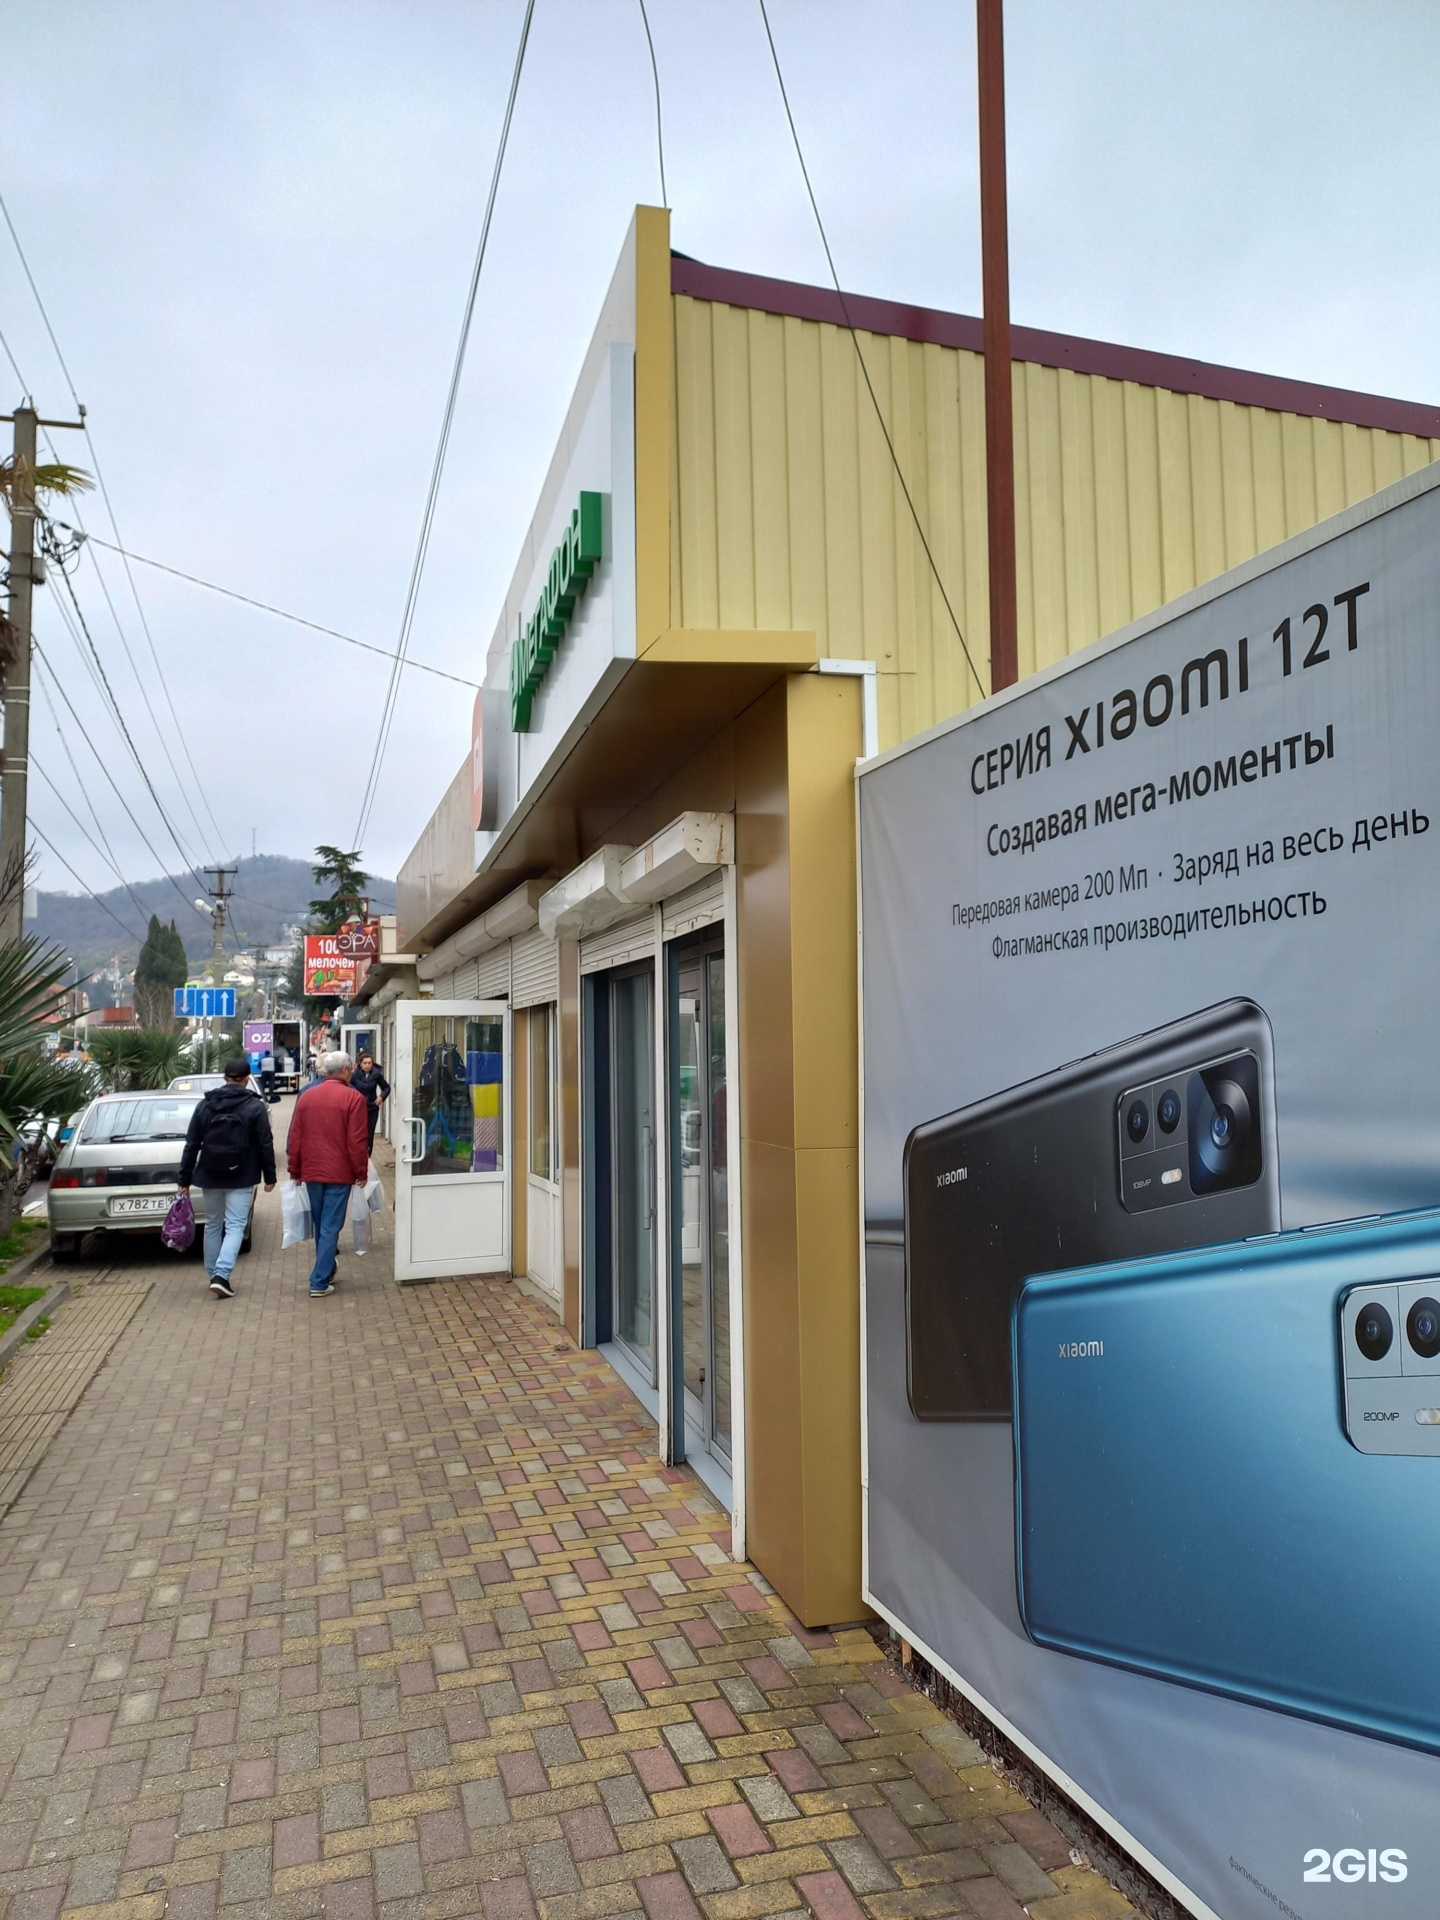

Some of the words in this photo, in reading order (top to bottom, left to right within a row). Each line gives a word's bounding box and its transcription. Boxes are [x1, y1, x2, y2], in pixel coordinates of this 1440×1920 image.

[970, 726, 1052, 796] СЕРИЯ
[1273, 582, 1371, 677] 12T
[987, 803, 1087, 857] Создавая
[1094, 724, 1335, 826] мега-моменты
[952, 894, 1021, 926] Передовая
[1025, 880, 1079, 914] камера
[1084, 870, 1115, 900] 200
[1119, 864, 1149, 896] Мп
[1174, 845, 1240, 884] Заряд
[1247, 838, 1275, 868] на
[1283, 821, 1345, 859] весь
[1353, 808, 1431, 852] день
[991, 923, 1089, 960] Флагманская
[1094, 890, 1328, 950] производительность
